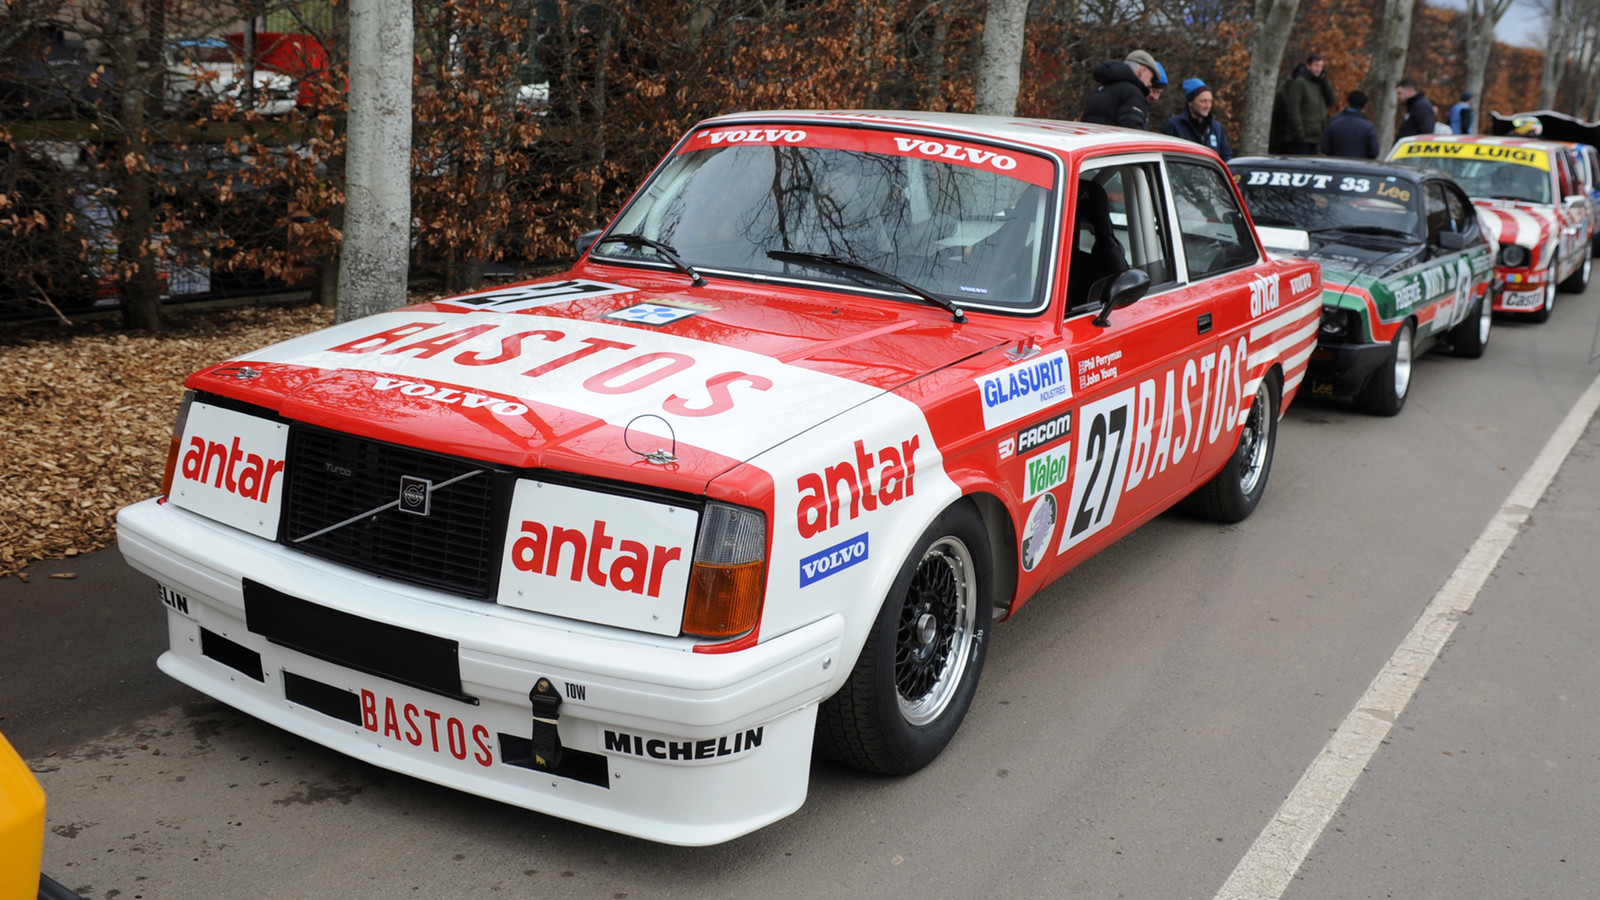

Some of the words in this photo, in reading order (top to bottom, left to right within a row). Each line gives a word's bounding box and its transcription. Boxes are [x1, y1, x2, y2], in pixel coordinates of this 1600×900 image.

[708, 129, 807, 145] VOLVO
[893, 137, 1018, 171] VOLVO
[1407, 143, 1463, 155] BMW
[1475, 148, 1536, 163] LUIGI
[1247, 171, 1333, 189] BRUT
[1339, 177, 1370, 193] 33
[1377, 182, 1411, 202] Lee
[959, 285, 988, 294] VOLVO
[324, 321, 774, 417] BASTOS
[984, 356, 1064, 408] GLASURIT
[1100, 366, 1118, 380] Young
[372, 376, 529, 416] VOLVO
[1040, 384, 1067, 403] INDUSTRIES
[1018, 414, 1071, 452] FACOM
[1125, 335, 1247, 493] BASTOS
[182, 435, 285, 504] antar
[325, 462, 352, 477] Turbo
[797, 434, 920, 539] antar
[1028, 454, 1066, 496] Valeo
[1069, 404, 1128, 540] 27
[511, 519, 682, 598] antar
[802, 541, 866, 579] VOLVO
[564, 682, 587, 701] TOW
[360, 688, 493, 768] BASTOS
[603, 726, 764, 761] MICHELIN
